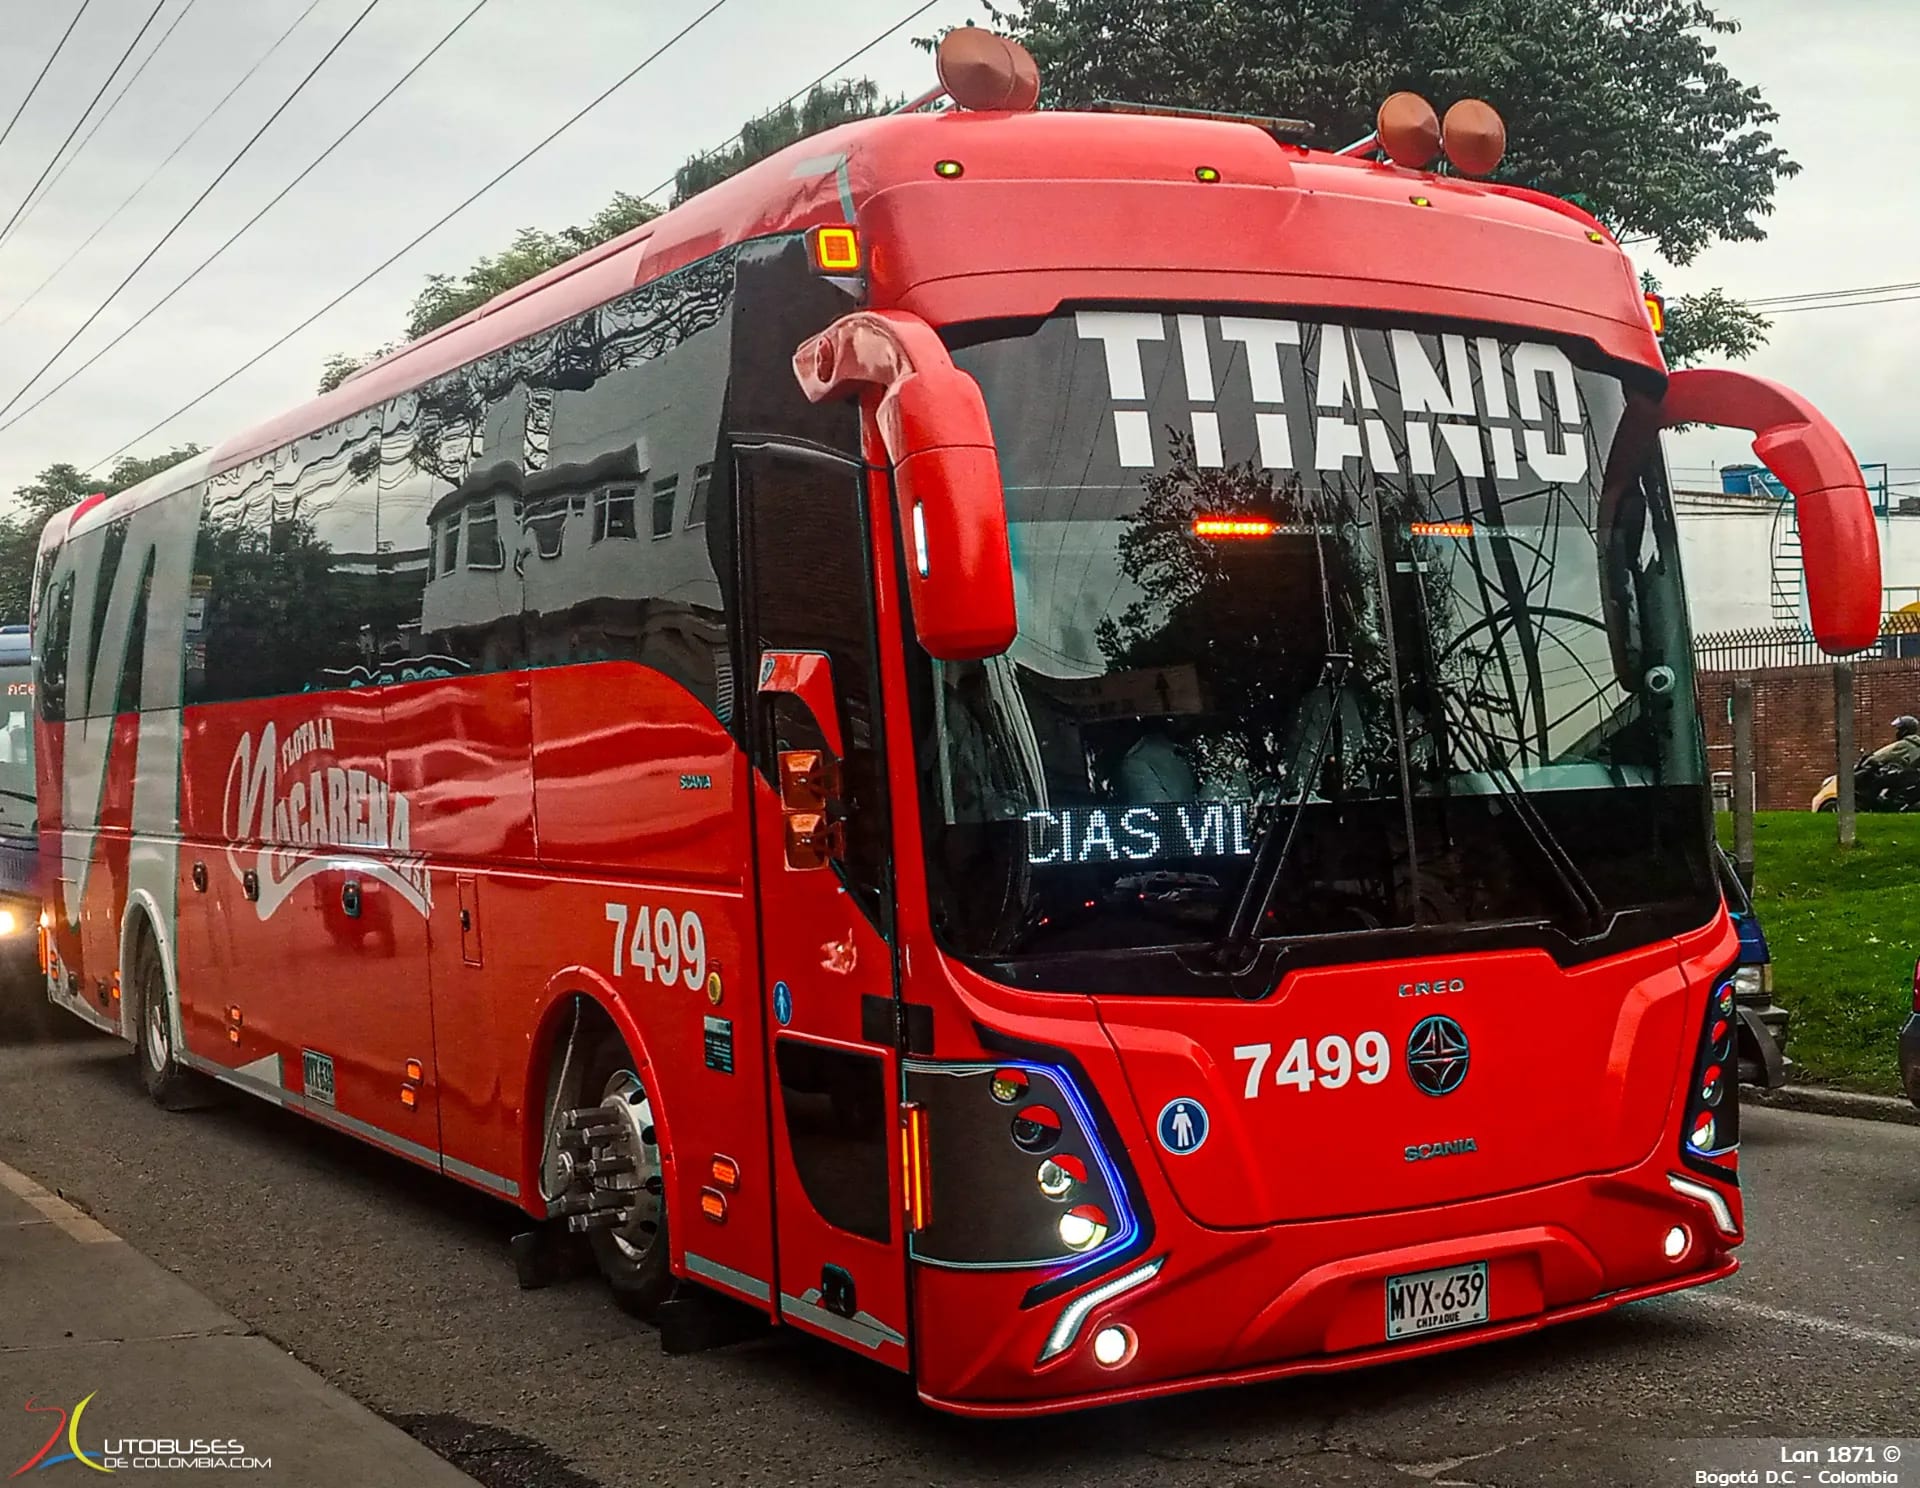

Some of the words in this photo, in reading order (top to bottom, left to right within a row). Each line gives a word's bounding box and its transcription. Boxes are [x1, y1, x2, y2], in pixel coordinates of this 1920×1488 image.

[1074, 310, 1588, 484] TITANIO
[282, 720, 317, 774] FLOTA
[318, 718, 334, 750] LA
[605, 902, 705, 991] 7499
[1398, 978, 1465, 998] CREO
[1233, 1031, 1391, 1100] 7499
[1404, 1137, 1478, 1162] SCANIA
[1416, 1311, 1461, 1329] CHIPAQUE
